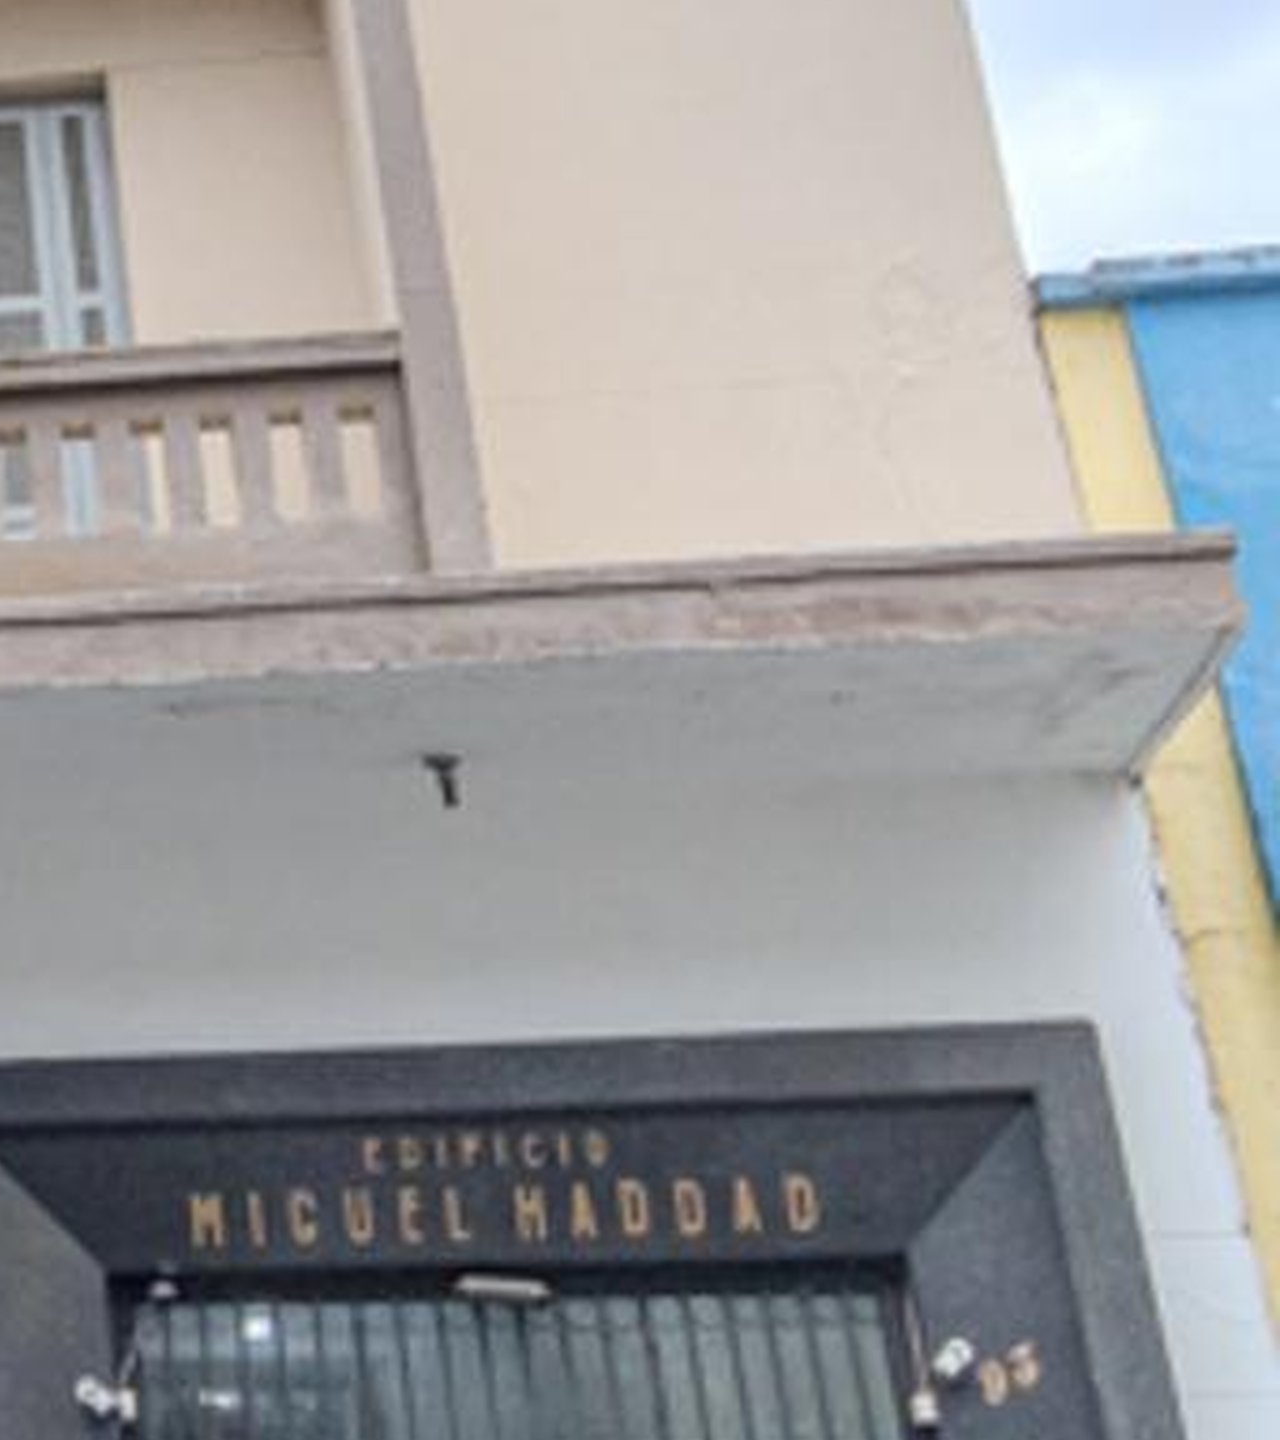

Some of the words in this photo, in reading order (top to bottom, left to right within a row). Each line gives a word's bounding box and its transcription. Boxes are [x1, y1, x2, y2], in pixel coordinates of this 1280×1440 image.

[360, 1129, 610, 1174] EDIFICIO
[186, 1183, 472, 1249] MIGUEL
[513, 1173, 822, 1242] HADDAD
